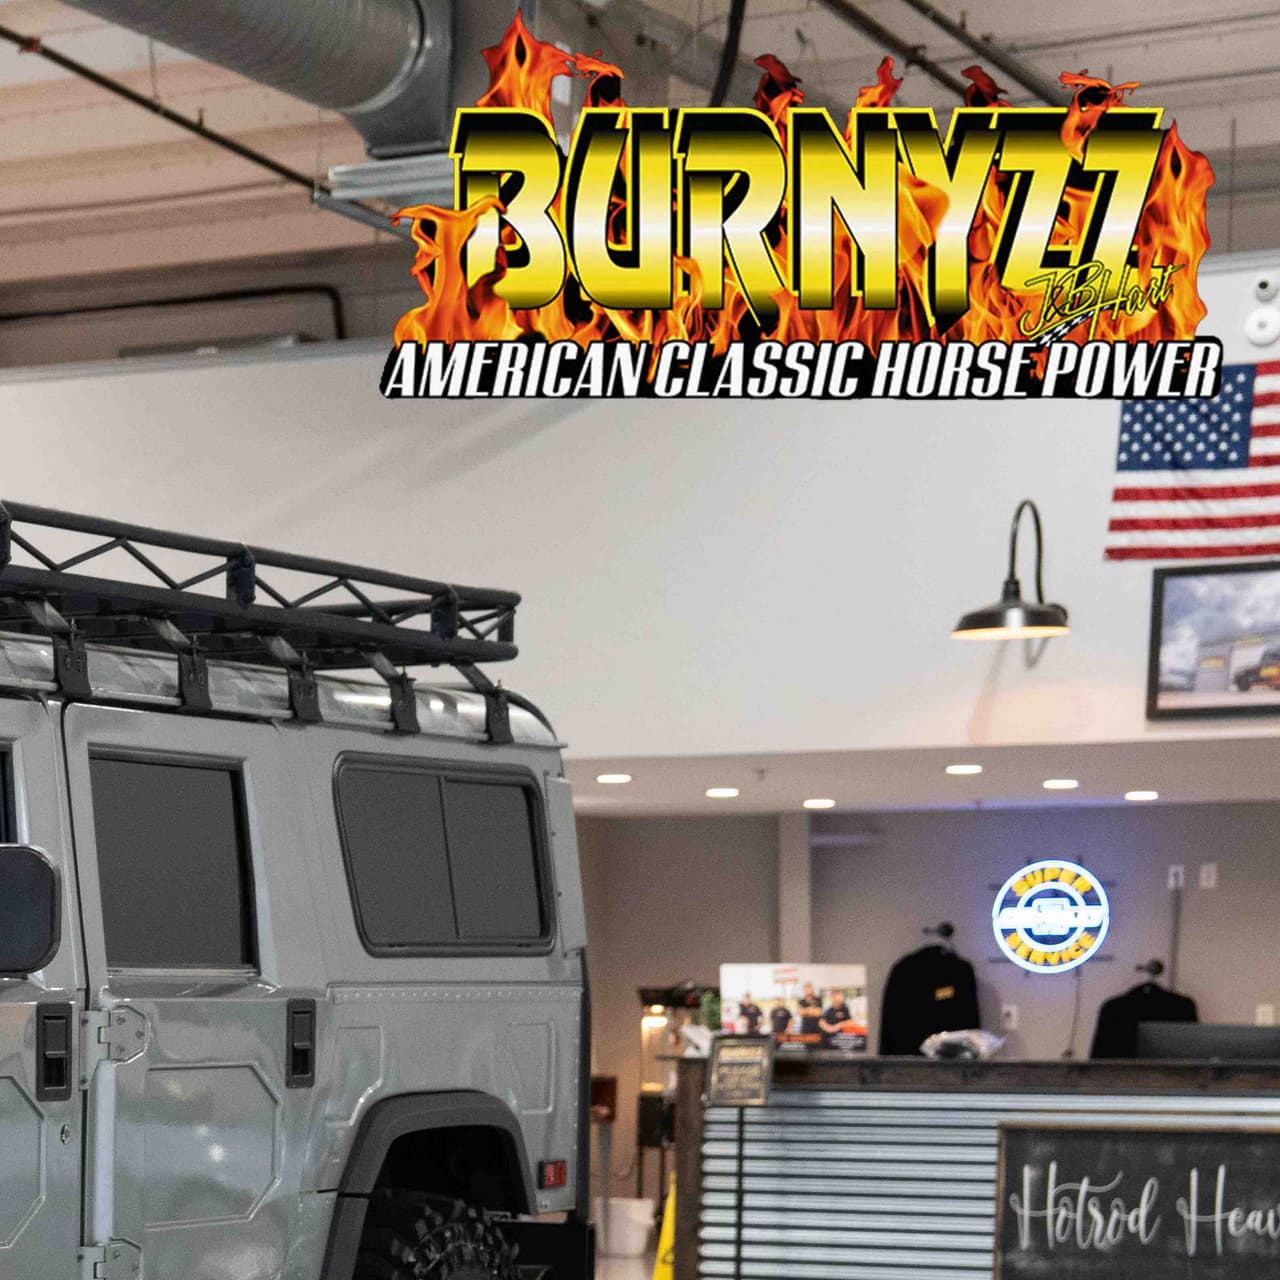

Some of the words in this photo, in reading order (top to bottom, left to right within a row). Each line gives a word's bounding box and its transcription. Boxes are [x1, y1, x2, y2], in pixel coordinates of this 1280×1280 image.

[1011, 867, 1093, 897] SUPER
[1006, 932, 1096, 966] SERVICE
[1009, 1160, 1162, 1250] Hotrod
